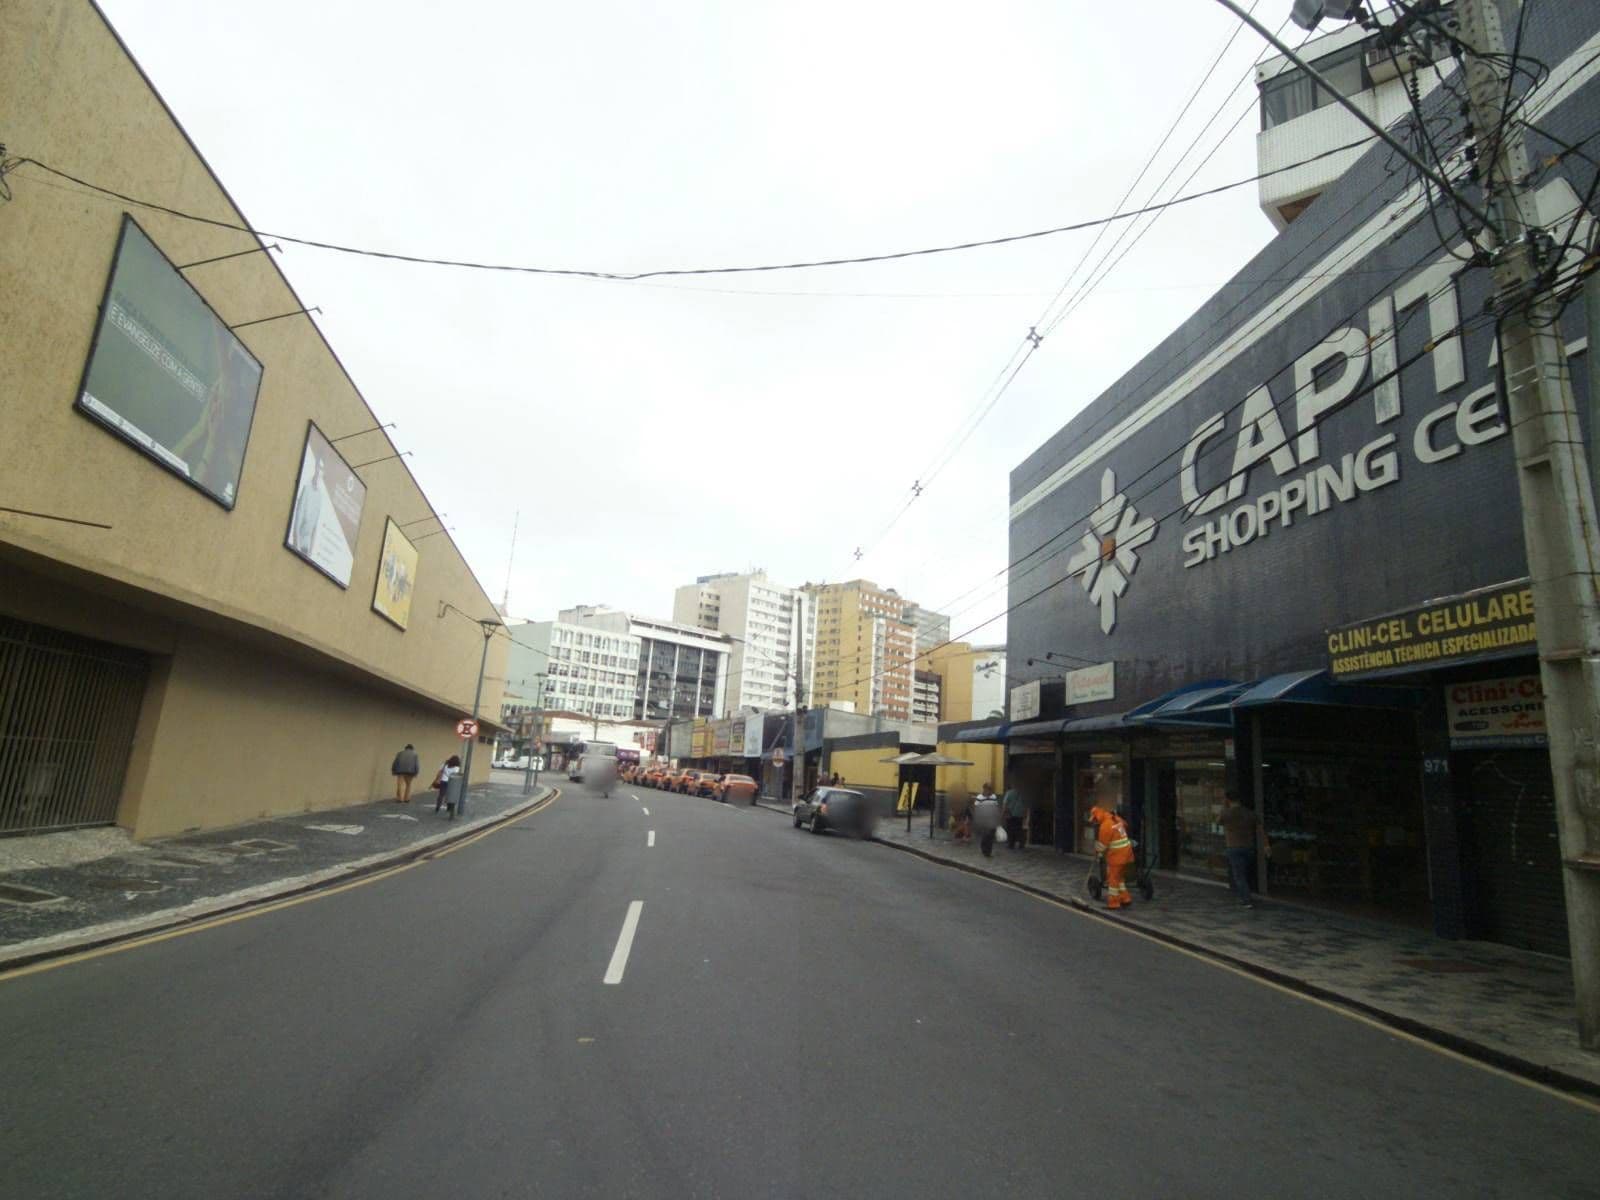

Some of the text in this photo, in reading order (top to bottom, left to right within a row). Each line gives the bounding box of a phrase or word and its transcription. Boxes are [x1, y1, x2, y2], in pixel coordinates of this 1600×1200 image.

[1182, 433, 1398, 568] SHOPPING
[1328, 619, 1413, 654] CLINI-CEL
[1442, 623, 1537, 656] ESPECIALIZADA
[1424, 759, 1449, 773] 971
